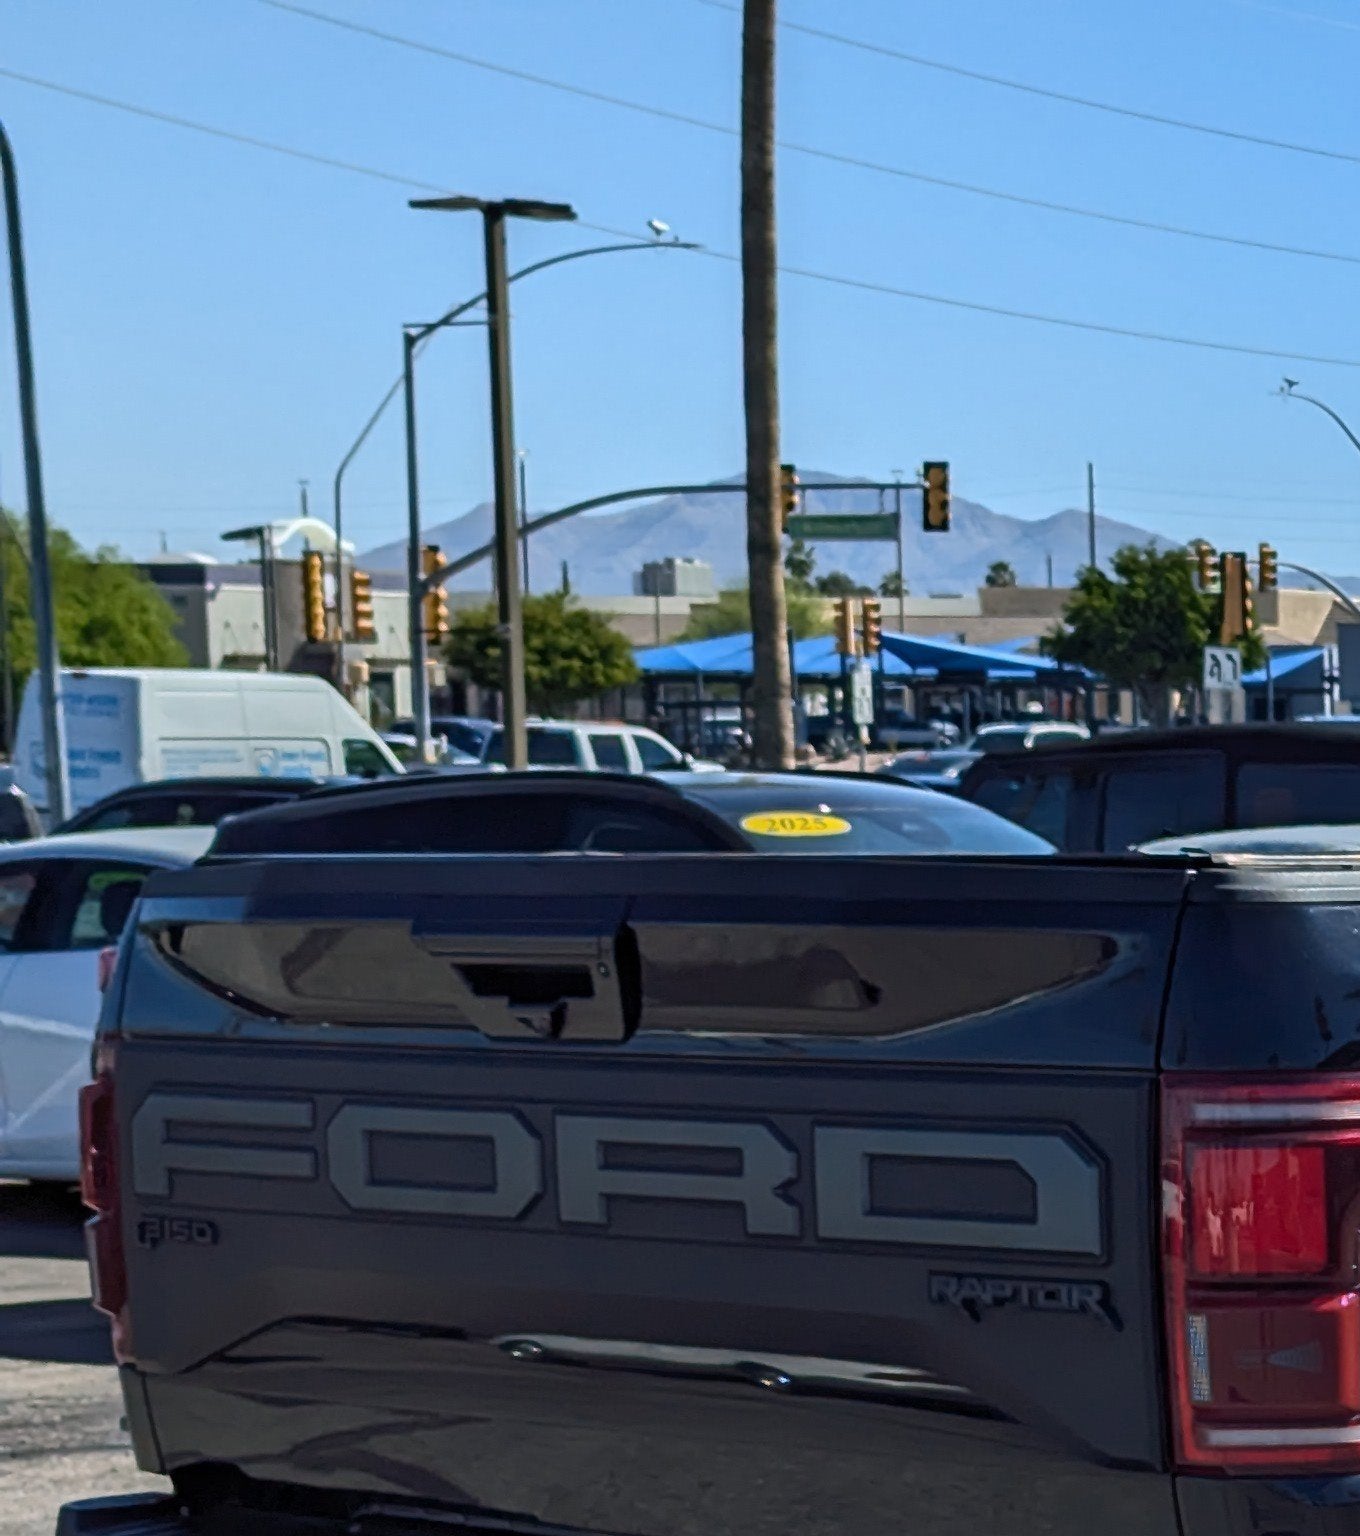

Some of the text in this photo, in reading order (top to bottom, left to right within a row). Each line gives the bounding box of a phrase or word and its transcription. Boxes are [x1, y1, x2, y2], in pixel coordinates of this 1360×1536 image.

[768, 817, 827, 831] 2025
[132, 1092, 1102, 1258] FORD
[929, 1271, 1122, 1331] RAPTOR
